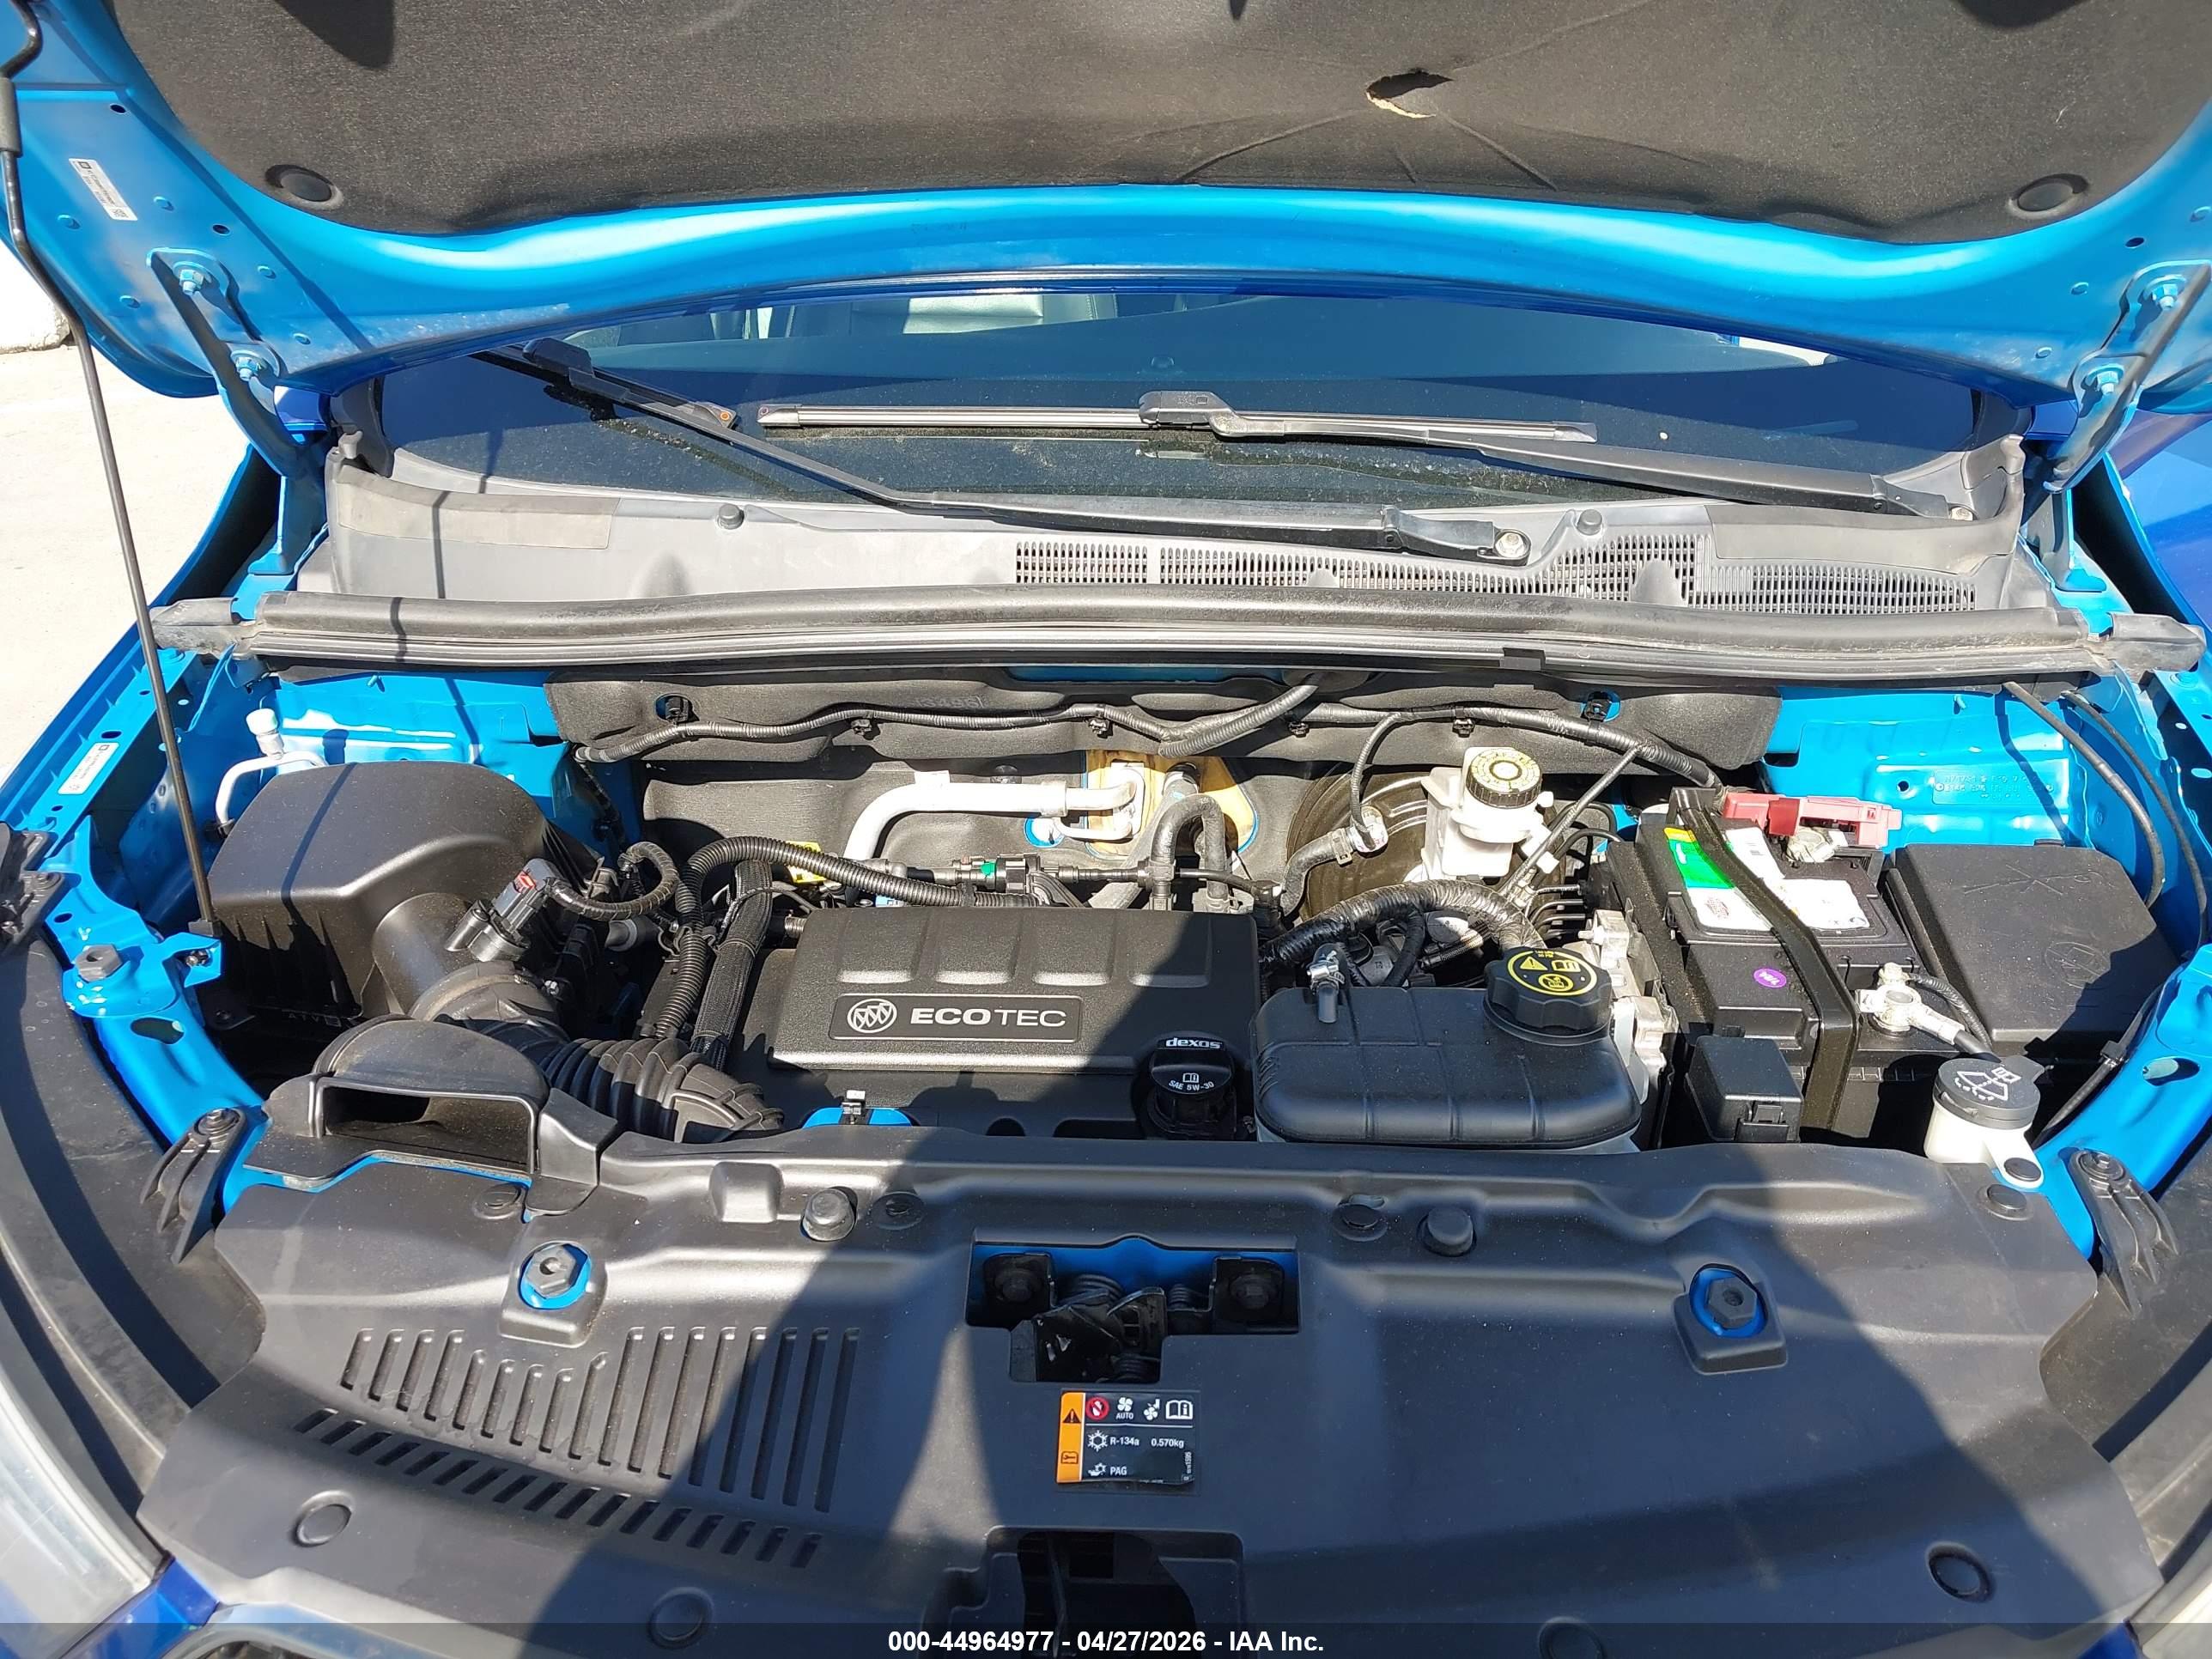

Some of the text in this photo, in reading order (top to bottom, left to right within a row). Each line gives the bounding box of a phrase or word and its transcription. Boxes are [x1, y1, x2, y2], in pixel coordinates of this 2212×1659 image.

[910, 1007, 1066, 1027] ECOTEC
[1165, 1037, 1222, 1049] dexos
[1169, 1079, 1215, 1091] SAE 5W-30
[1109, 1437, 1185, 1449] R-134a 0.570kg
[1109, 1466, 1127, 1476] PAG
